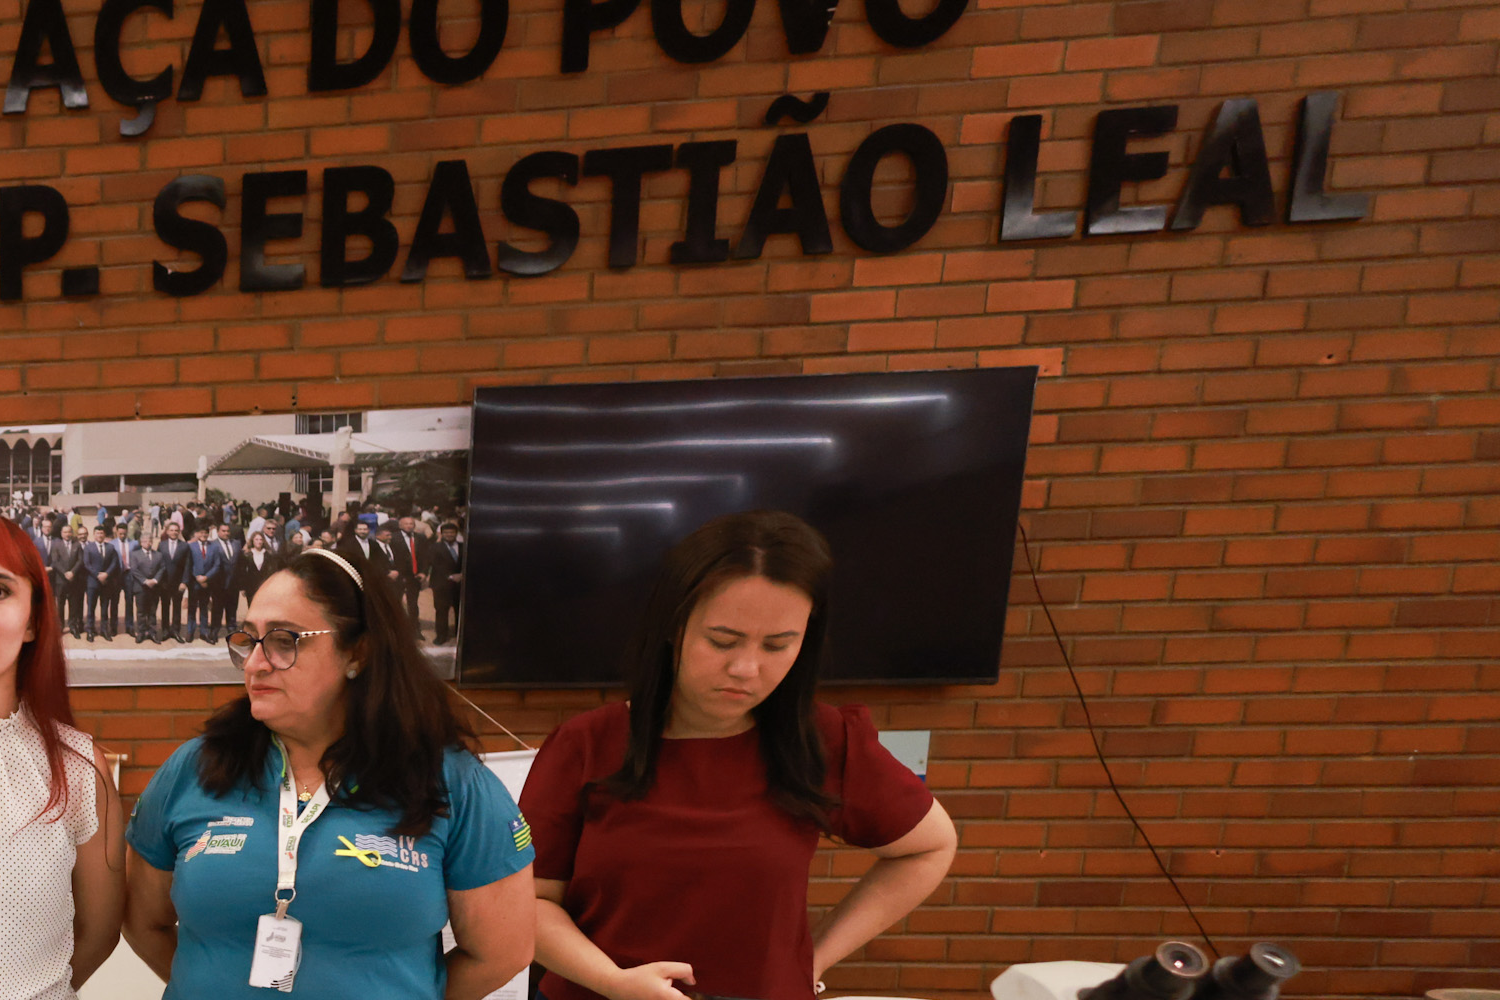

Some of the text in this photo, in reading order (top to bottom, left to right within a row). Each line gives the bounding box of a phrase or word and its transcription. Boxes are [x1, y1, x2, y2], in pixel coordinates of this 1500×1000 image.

[307, 0, 509, 93] DO
[152, 92, 949, 297] SEBASTIÃO
[1001, 90, 1376, 242] LEAL
[300, 803, 322, 824] SESAPI
[398, 835, 415, 851] IV
[400, 848, 429, 868] CRS
